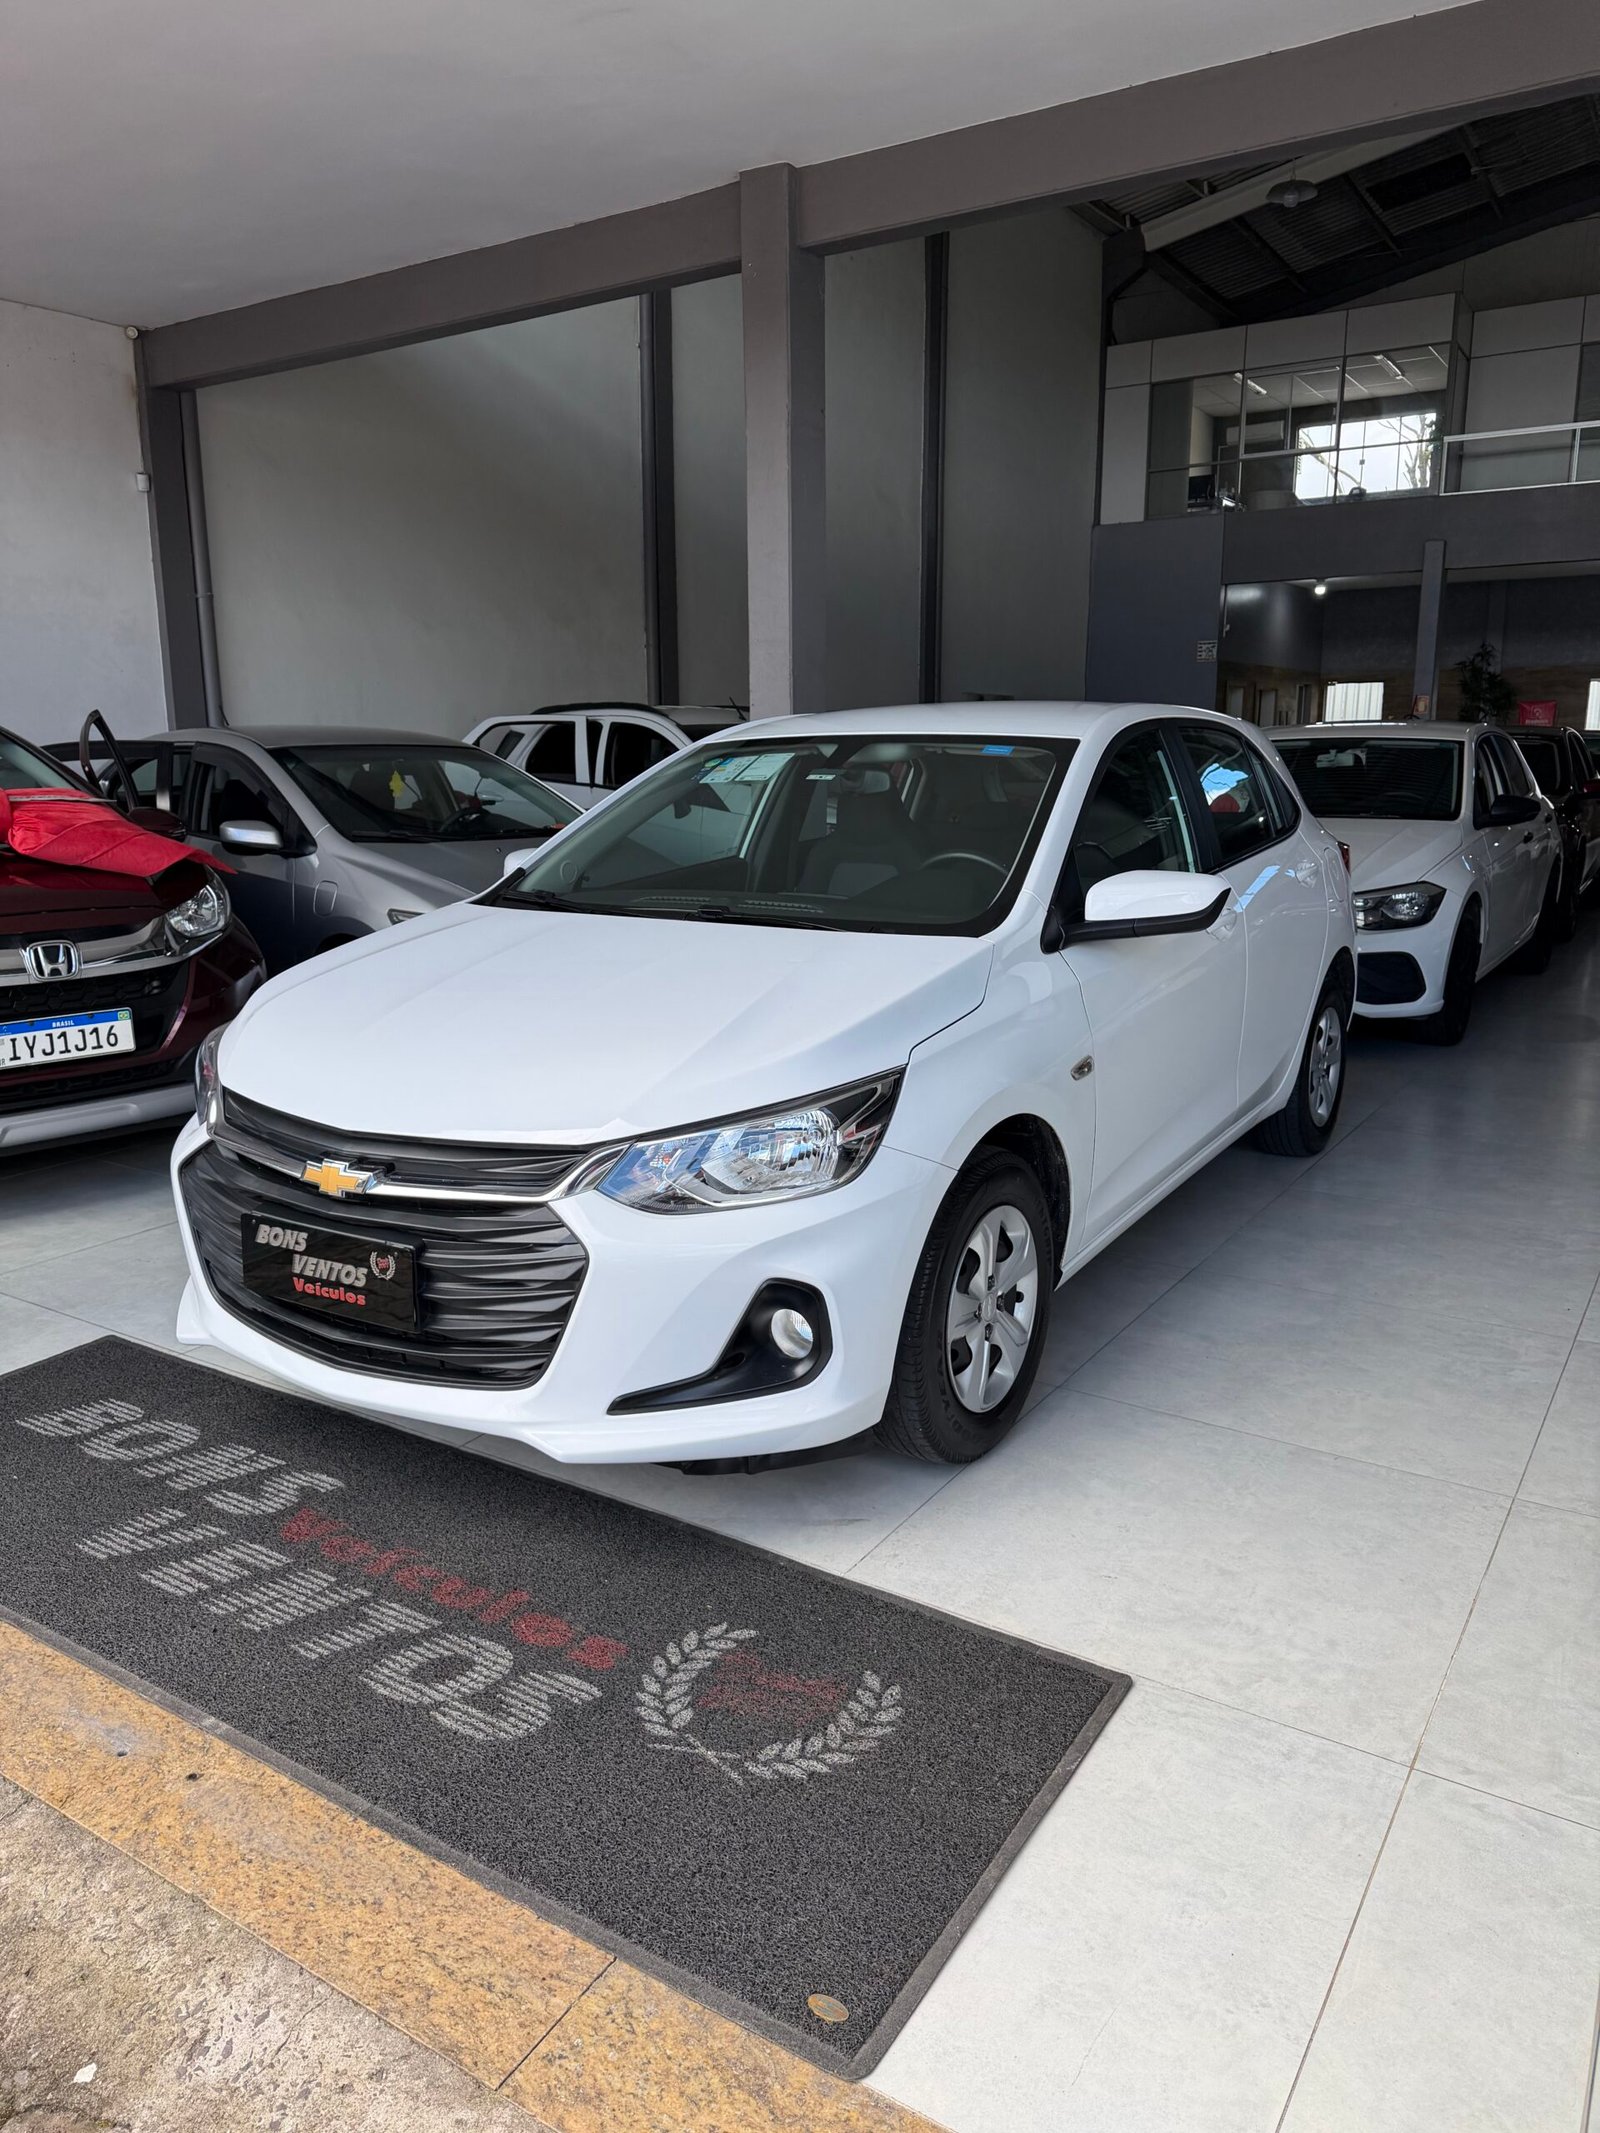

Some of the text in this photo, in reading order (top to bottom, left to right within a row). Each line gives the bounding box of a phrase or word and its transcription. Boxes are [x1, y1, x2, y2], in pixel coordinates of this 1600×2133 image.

[52, 1020, 75, 1028] BRASIL
[9, 1025, 118, 1061] IYJ1J16
[255, 1224, 308, 1252] BONS
[292, 1253, 368, 1288] VENTOS
[292, 1276, 366, 1306] Veículos
[15, 1398, 345, 1515] BONS
[74, 1506, 602, 1742] VENTOS
